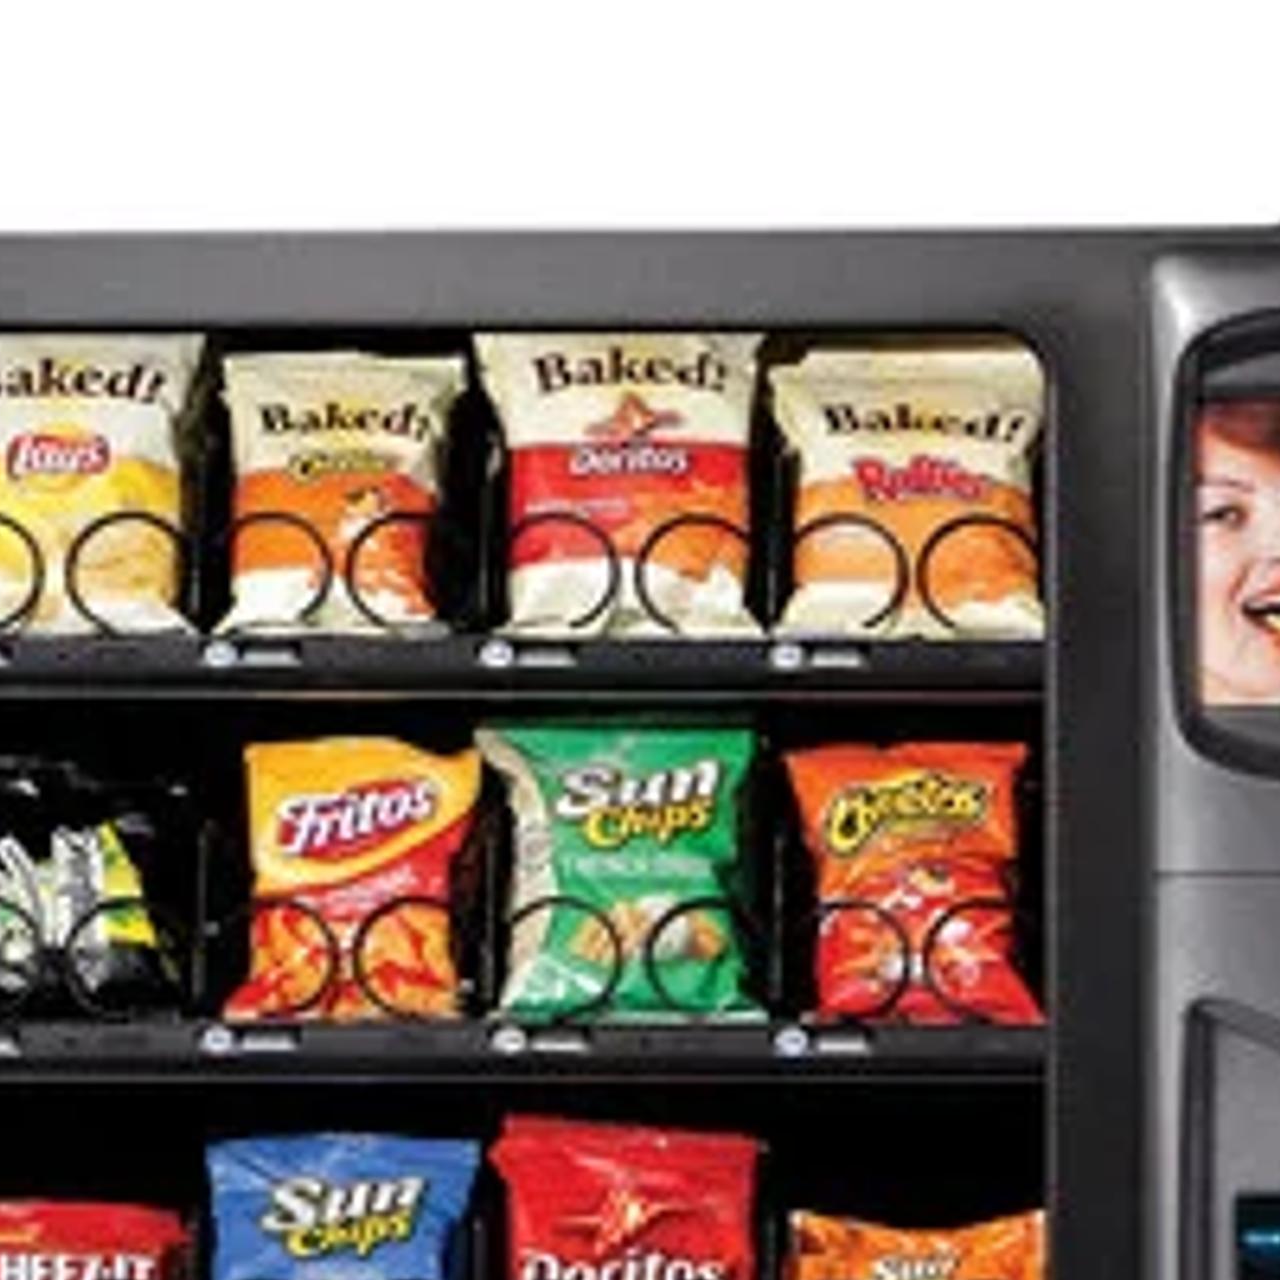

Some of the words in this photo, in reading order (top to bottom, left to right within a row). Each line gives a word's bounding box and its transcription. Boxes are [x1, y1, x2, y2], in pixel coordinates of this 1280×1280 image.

[533, 346, 728, 394] Baked!
[824, 403, 1026, 444] Baked!
[556, 759, 720, 818] Sun
[276, 776, 437, 854] Fritos
[582, 800, 714, 848] Chips
[261, 1176, 424, 1232] Sun
[286, 1213, 415, 1258] Chips
